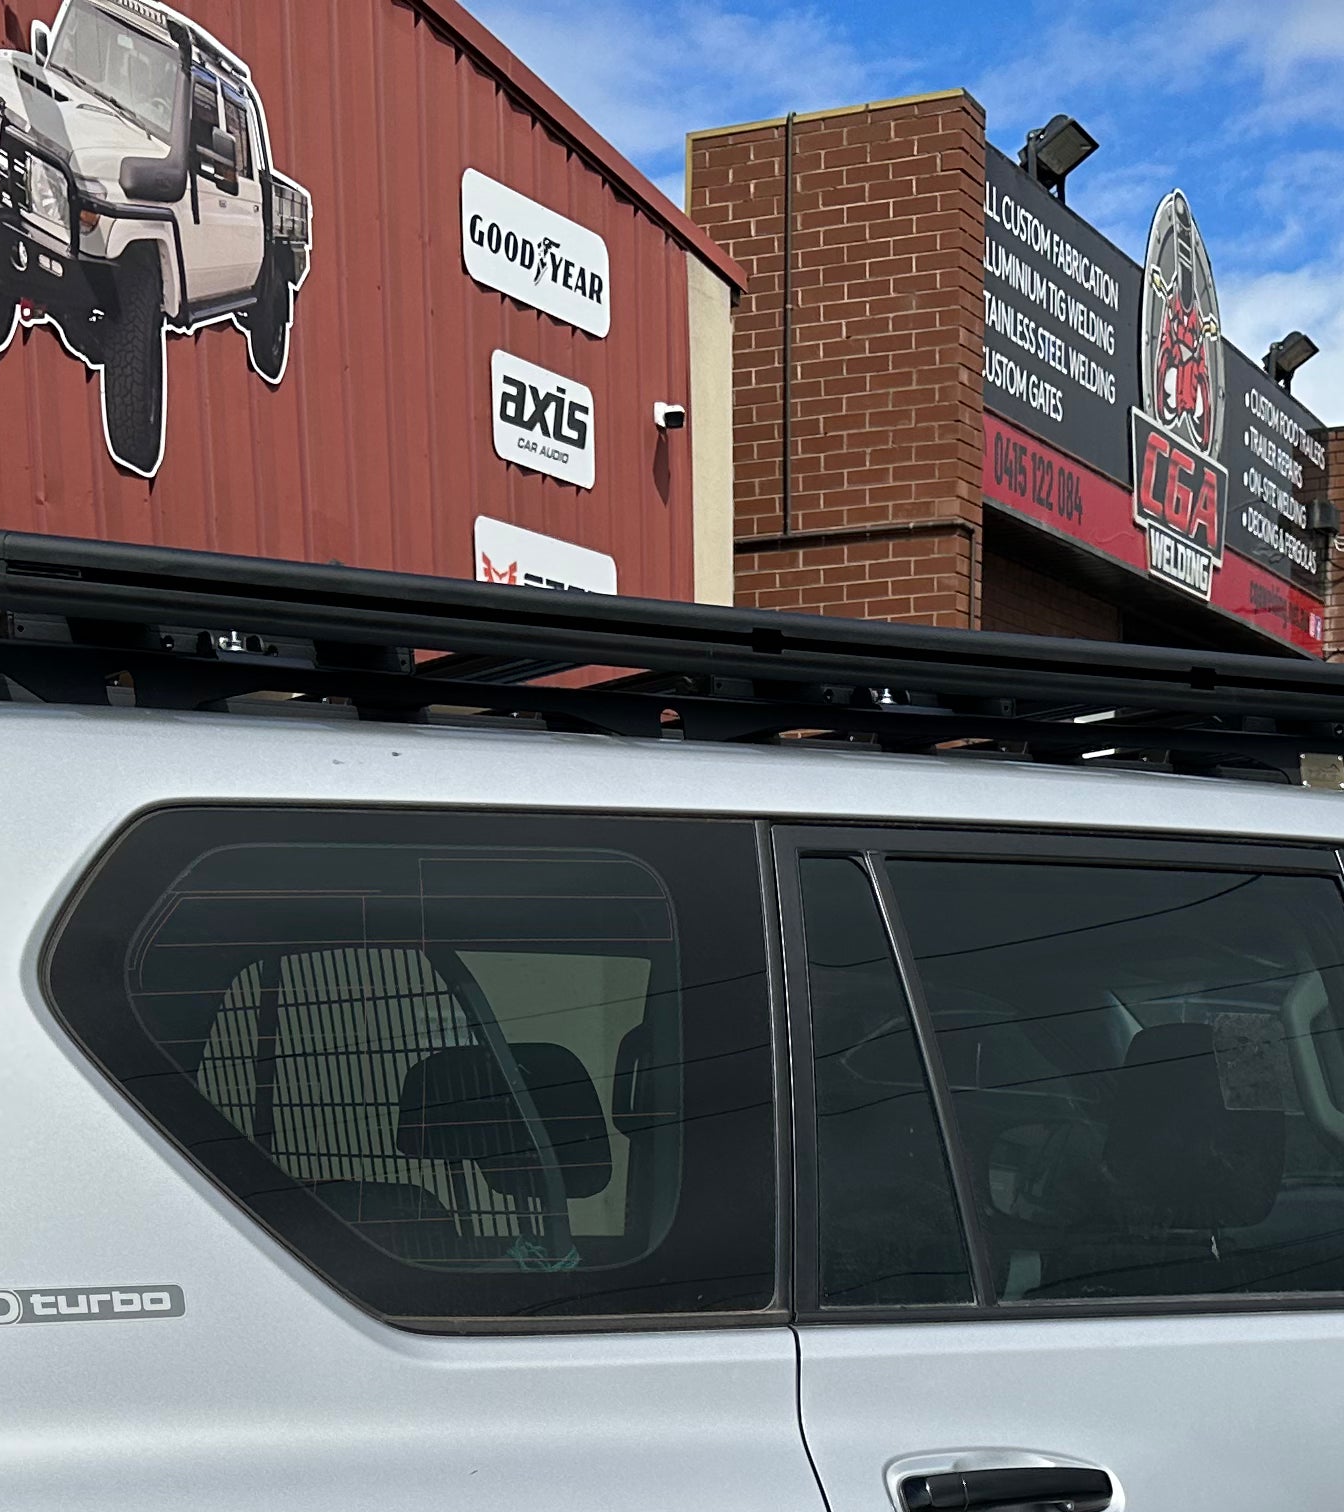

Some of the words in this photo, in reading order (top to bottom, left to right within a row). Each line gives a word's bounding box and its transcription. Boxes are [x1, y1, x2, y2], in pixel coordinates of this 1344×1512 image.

[983, 181, 1000, 223] LL
[1002, 195, 1050, 260] CUSTOM
[1053, 233, 1119, 312] FABRICATION
[983, 236, 1047, 309] LUMINIUM
[1048, 281, 1066, 323] TIG
[1067, 295, 1115, 356] WELDING
[982, 346, 1027, 402] USTOM
[1029, 374, 1063, 422] GATES
[983, 289, 1036, 354] TAINLESS
[1038, 326, 1068, 375] STEEL
[1069, 346, 1116, 404] WELDING
[500, 375, 589, 450] axis
[1250, 388, 1279, 433] CUSTOM
[1279, 411, 1299, 447] FOOD
[1299, 422, 1326, 471] TRAILERS
[517, 437, 538, 454] CAR
[539, 444, 569, 464] AUDIO
[994, 431, 1027, 497] 0415
[1031, 452, 1053, 511] 122
[1058, 467, 1083, 525] 084
[1250, 426, 1276, 469] TRAILER
[1277, 447, 1303, 489] REPAIRS
[1140, 431, 1218, 549] CGA
[1276, 488, 1307, 530] WELDING
[1150, 528, 1209, 591] WELDING
[1247, 506, 1278, 551] DECKING
[30, 1290, 172, 1316] turbo
